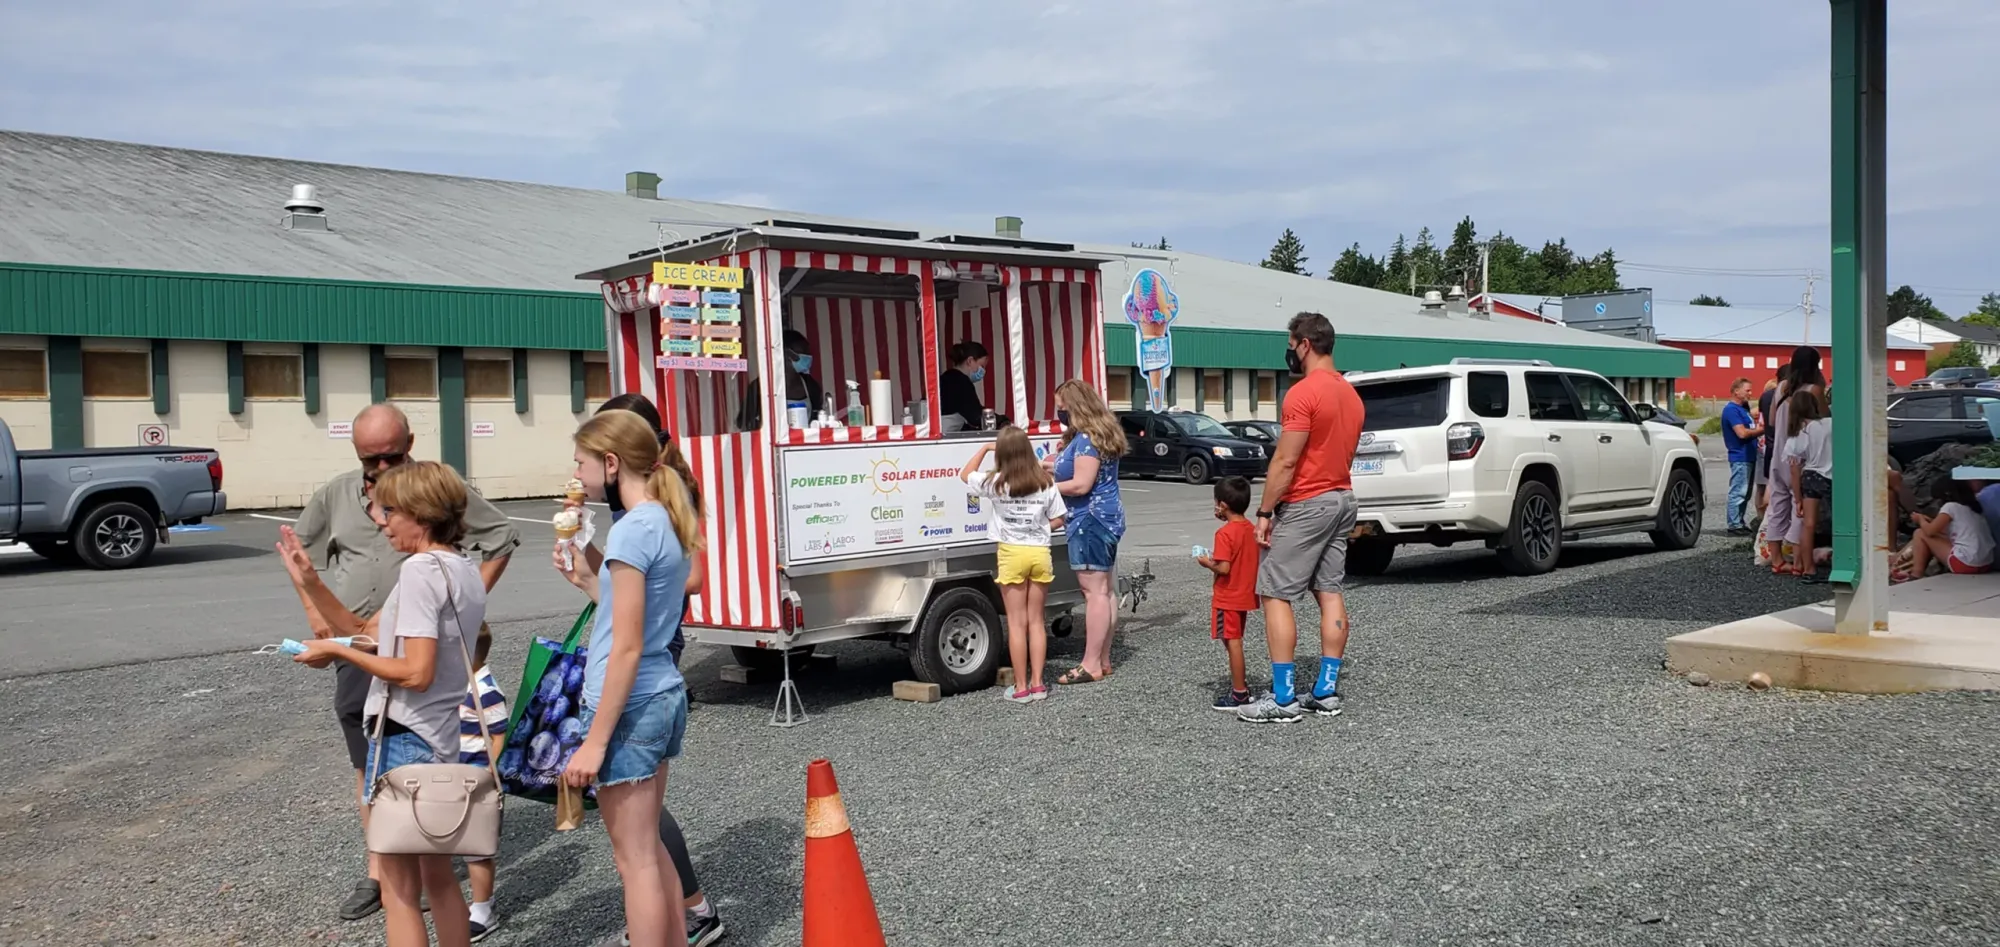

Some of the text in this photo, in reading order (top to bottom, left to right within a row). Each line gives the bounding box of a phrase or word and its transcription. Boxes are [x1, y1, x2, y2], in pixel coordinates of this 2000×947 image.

[663, 266, 738, 283] ICE CREAM
[155, 455, 183, 463] TRD
[790, 467, 961, 488] POWERED BY SOLAR ENERGY
[792, 503, 813, 511] Special
[871, 505, 904, 520] Clean
[930, 528, 953, 536] POWER
[964, 523, 988, 533] Celcold
[832, 535, 856, 546] LABOS
[804, 541, 822, 551] LABS
